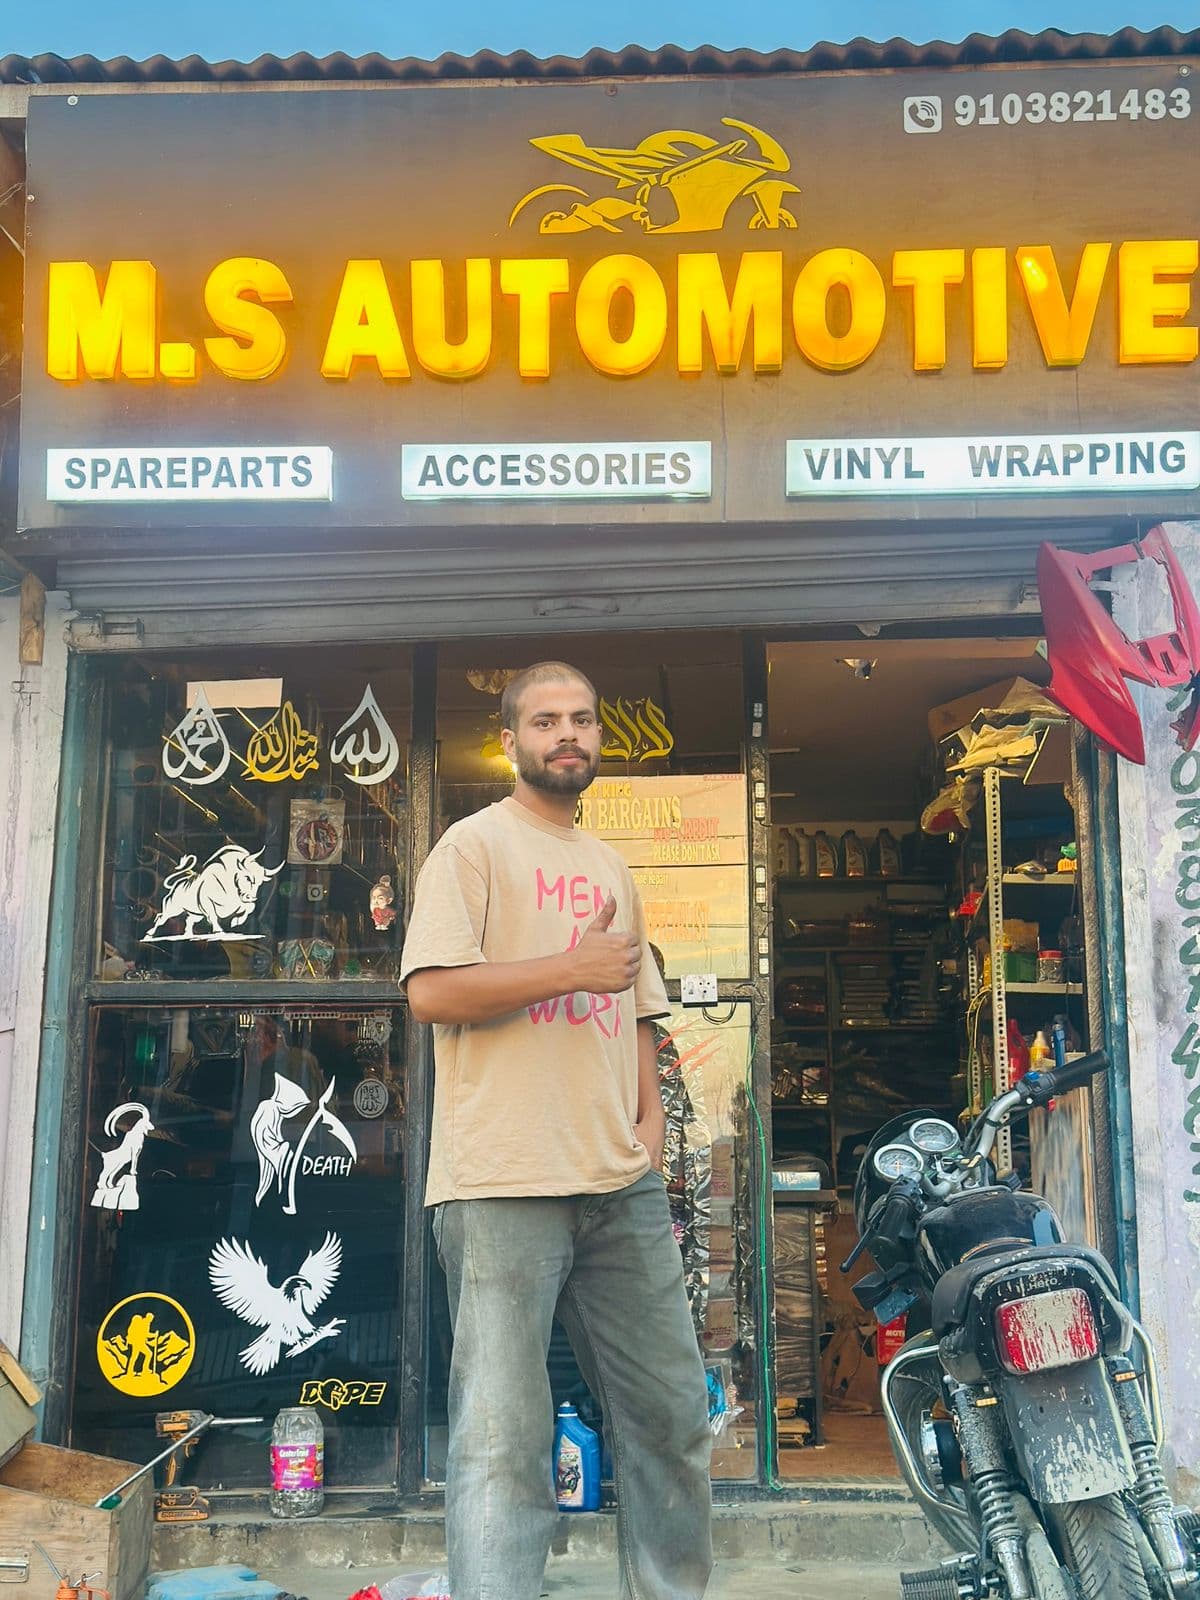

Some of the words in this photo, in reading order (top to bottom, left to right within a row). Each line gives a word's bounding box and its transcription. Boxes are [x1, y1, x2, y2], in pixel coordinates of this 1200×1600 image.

[954, 87, 1192, 126] 9103821483
[47, 256, 294, 381] M.S
[319, 240, 1199, 380] AUTOMOTIVE
[64, 454, 313, 489] SPAREPARTS
[417, 452, 692, 487] ACCESSORIES
[803, 447, 925, 480] VINYL
[967, 440, 1186, 478] WRAPPING
[596, 794, 682, 832] BARGAINS
[653, 843, 680, 863] PLEASE
[302, 1155, 353, 1177] DEATH
